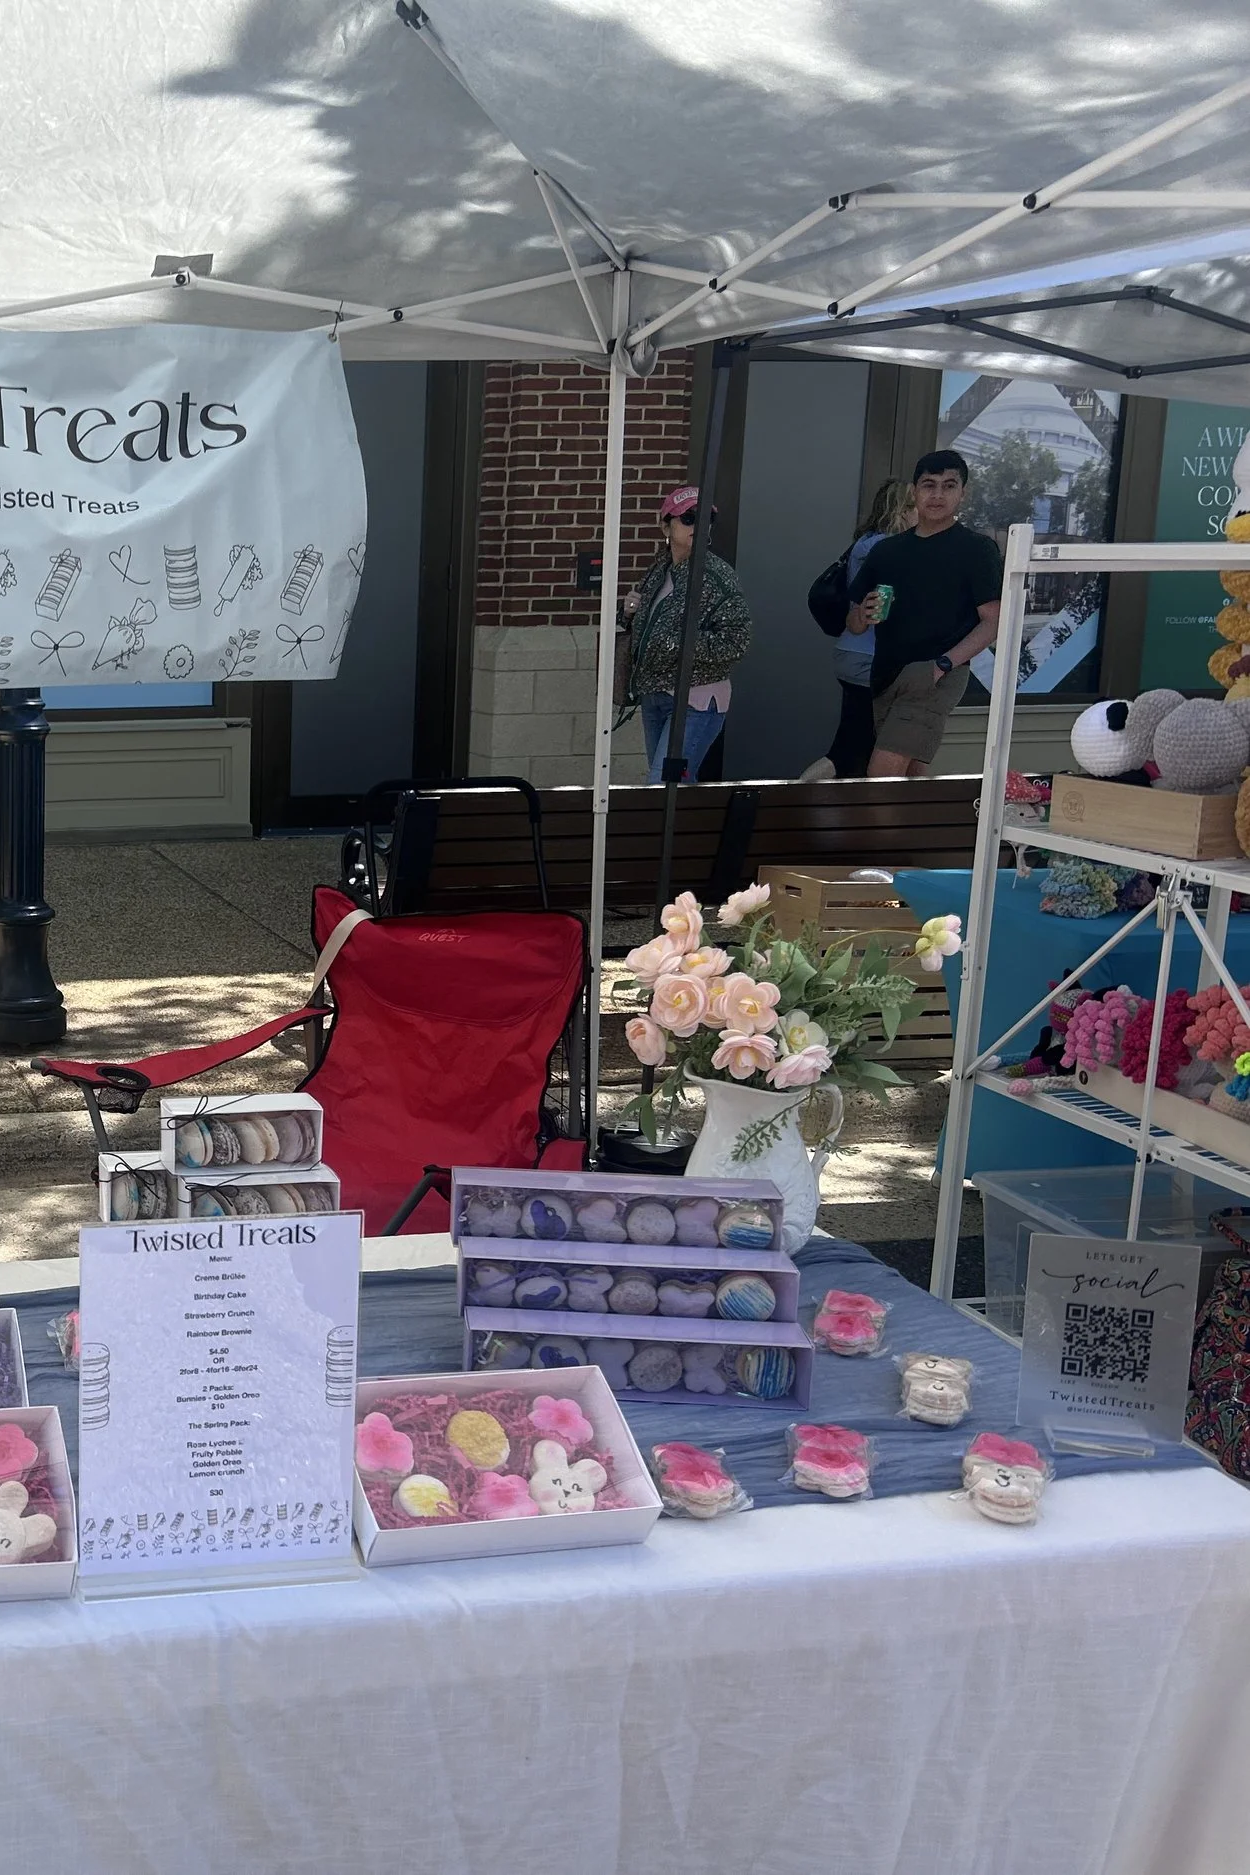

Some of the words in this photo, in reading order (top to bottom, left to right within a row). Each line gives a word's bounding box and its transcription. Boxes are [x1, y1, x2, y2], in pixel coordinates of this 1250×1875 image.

[1198, 427, 1212, 447] A
[1182, 456, 1233, 476] NEW
[61, 494, 140, 515] Treats
[1165, 616, 1197, 624] FOLLOW
[418, 932, 470, 943] QUEST
[126, 1224, 224, 1253] Twisted
[232, 1223, 316, 1247] Treats
[209, 1255, 233, 1263] Menu:
[1086, 1252, 1115, 1262] LETS
[1120, 1254, 1144, 1264] GET
[194, 1274, 220, 1282] Creme
[1042, 1268, 1185, 1298] social
[194, 1292, 226, 1302] Birthday
[227, 1291, 247, 1299] Cake
[184, 1311, 226, 1321] Strawberry
[227, 1309, 255, 1318] Crunch
[186, 1329, 220, 1338] Rainbow
[221, 1328, 253, 1337] Brownie
[209, 1347, 230, 1356] $4.50
[209, 1384, 234, 1393] Packs:
[176, 1394, 206, 1403] Bunnies
[213, 1393, 240, 1401] Golden
[242, 1391, 260, 1399] Oreo
[1049, 1390, 1156, 1411] TwistedTreats
[188, 1422, 202, 1430] The
[204, 1420, 228, 1430] Spring
[230, 1419, 251, 1428] Pack:
[186, 1441, 207, 1449] Rose
[208, 1439, 237, 1449] Lychee
[191, 1450, 214, 1460] Fruity
[216, 1448, 243, 1457] Pebble
[192, 1460, 221, 1469] Golden
[222, 1458, 242, 1467] Oreo
[189, 1470, 216, 1479] Lemon
[218, 1467, 245, 1477] crunch
[210, 1488, 224, 1497] $30
